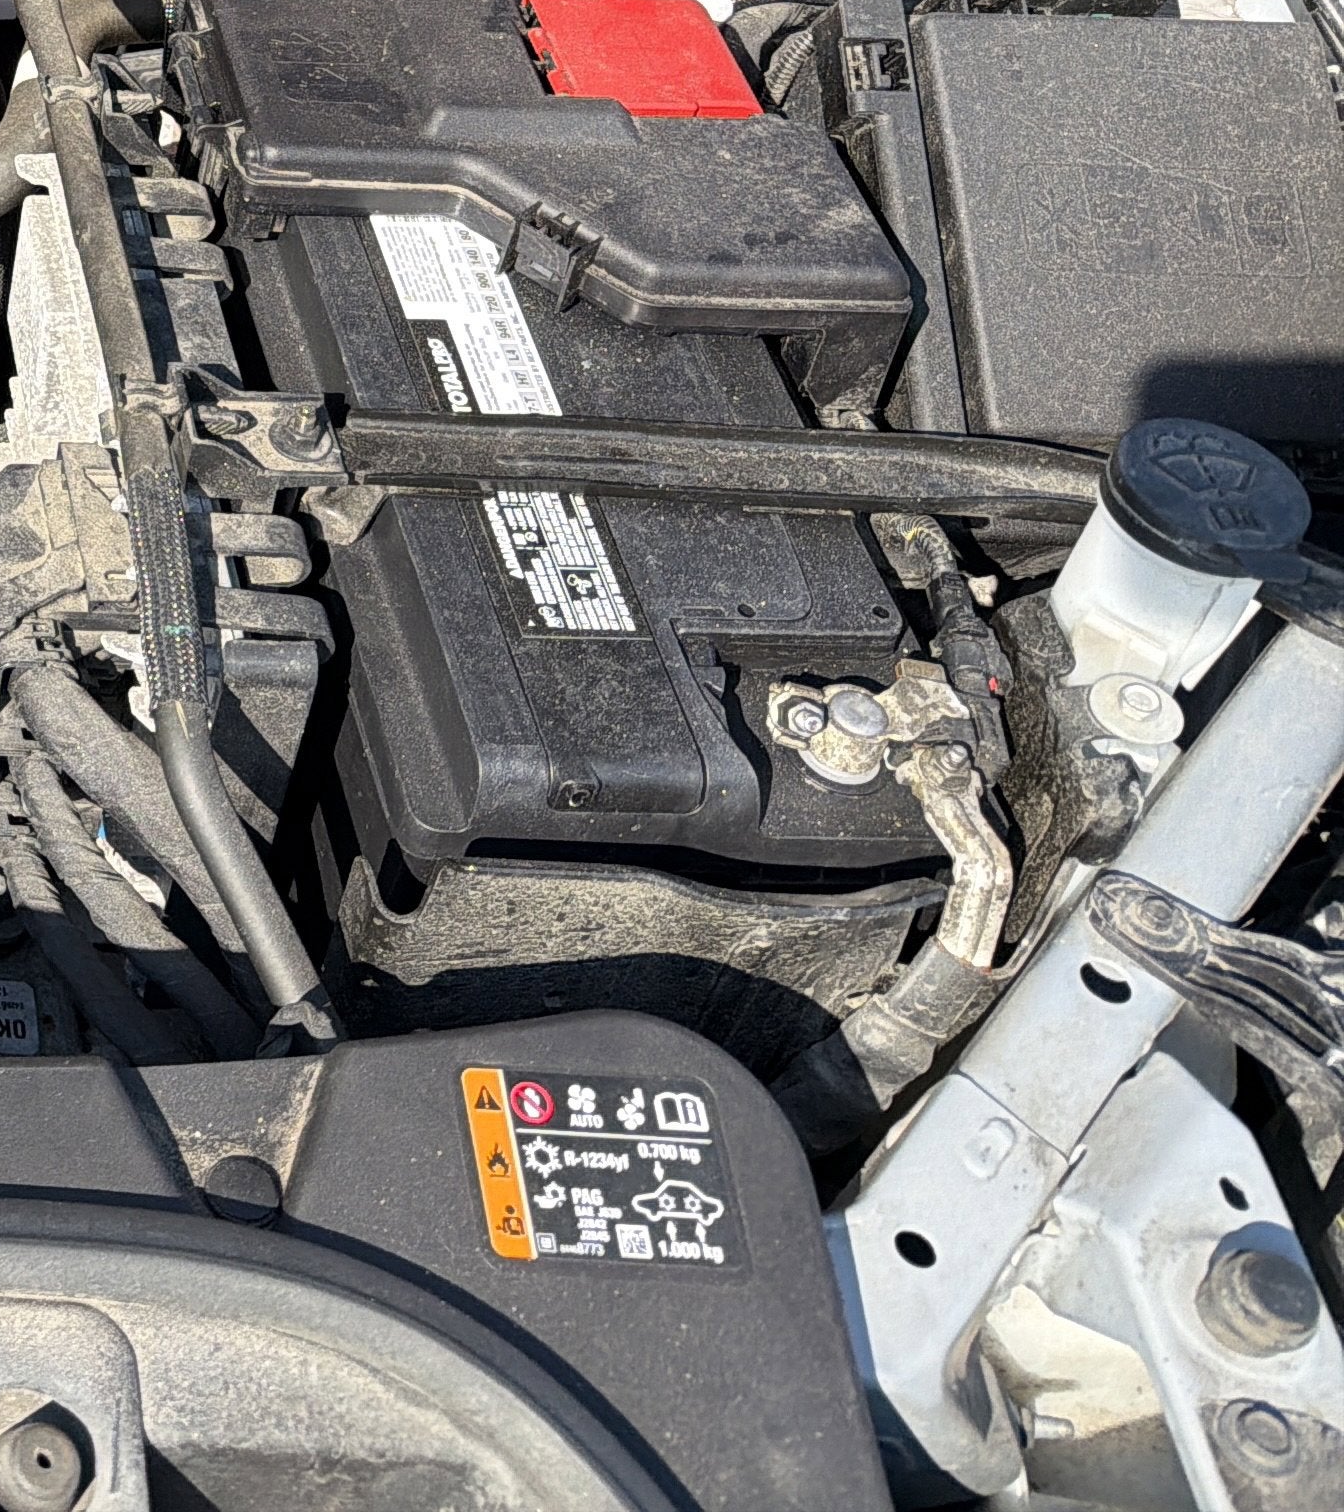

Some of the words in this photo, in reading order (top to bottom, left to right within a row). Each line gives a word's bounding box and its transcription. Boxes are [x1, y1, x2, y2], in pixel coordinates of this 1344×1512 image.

[458, 229, 471, 240] 80
[466, 249, 481, 264] 140
[475, 272, 490, 288] 900
[484, 295, 500, 312] 720
[494, 320, 509, 338] 94R
[514, 371, 527, 385] H7
[569, 1113, 605, 1129] AUTO
[563, 1150, 630, 1173] R-1234yf
[637, 1142, 678, 1161] 0.700
[679, 1144, 702, 1165] kg
[570, 1187, 604, 1206] PAG
[658, 1239, 702, 1260] 1.000
[703, 1243, 725, 1264] kg
